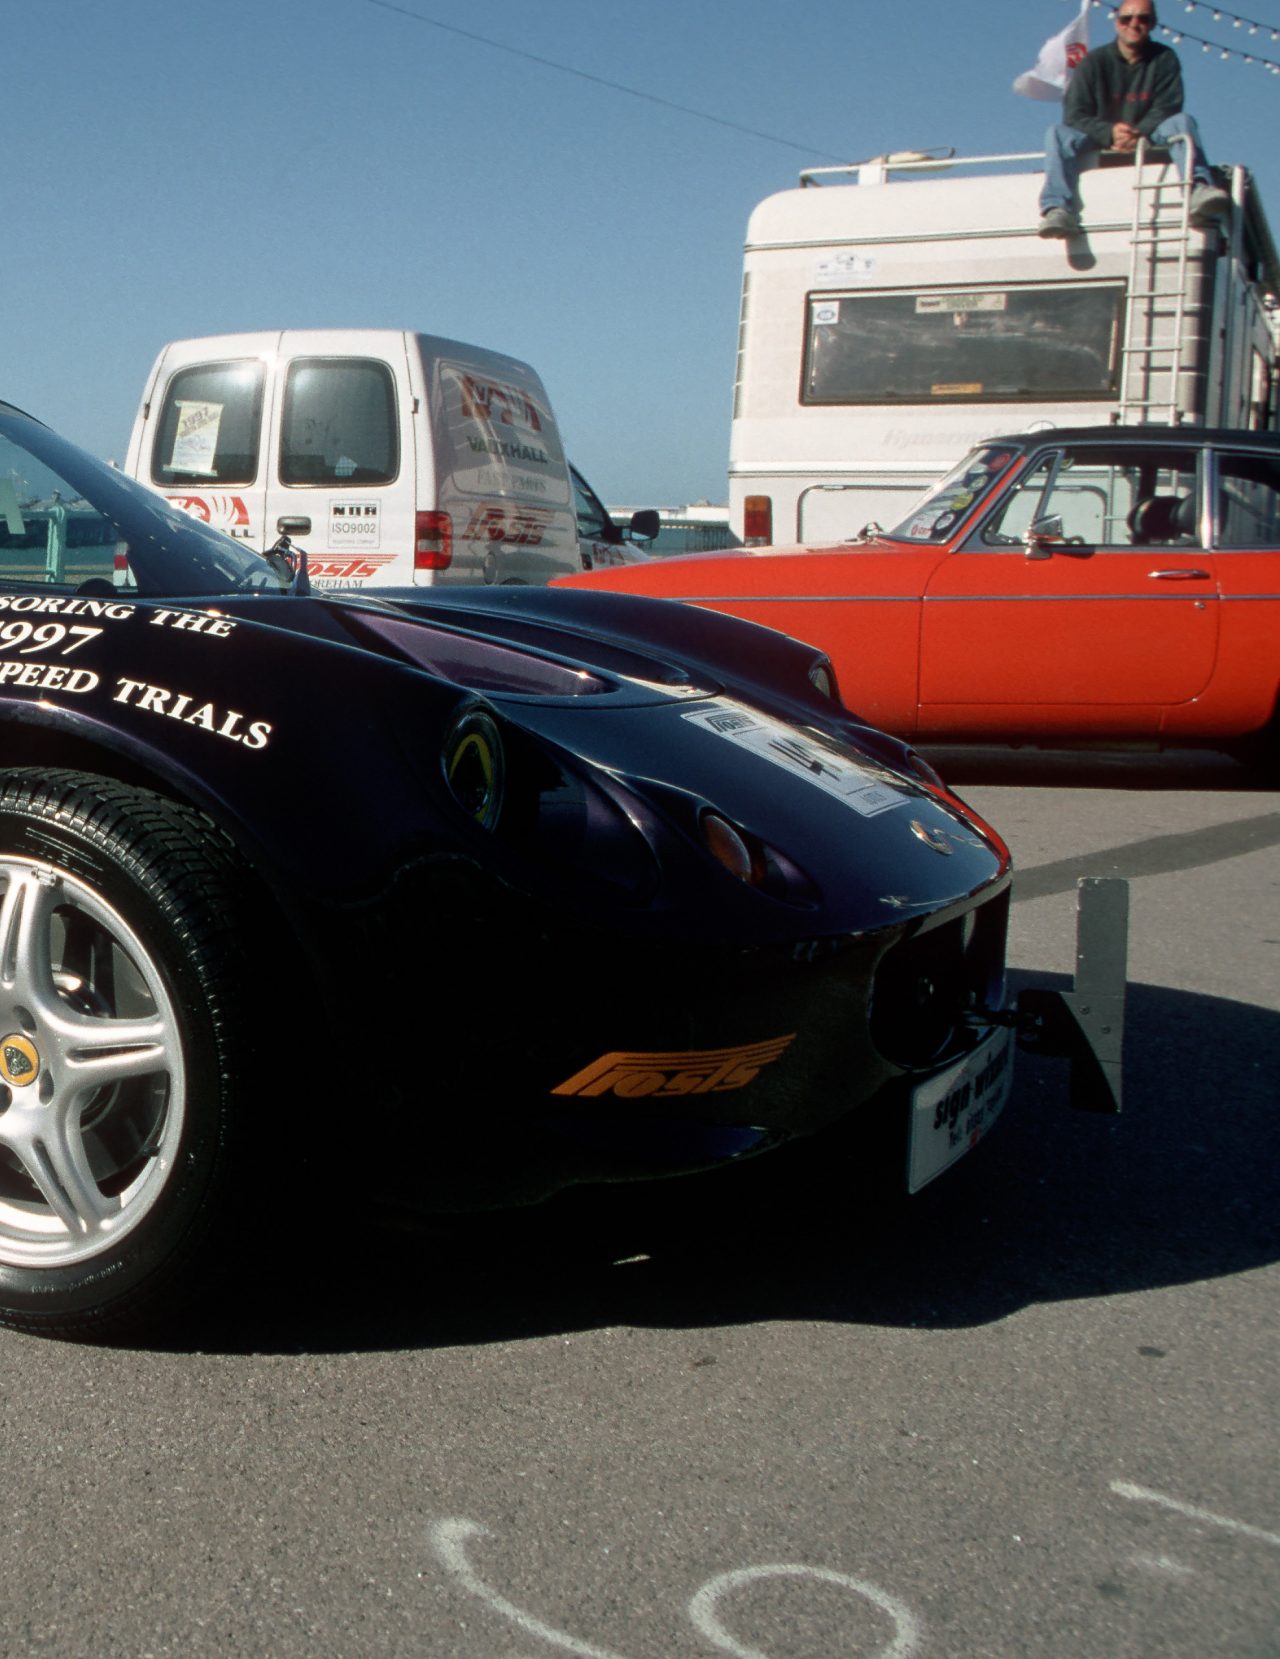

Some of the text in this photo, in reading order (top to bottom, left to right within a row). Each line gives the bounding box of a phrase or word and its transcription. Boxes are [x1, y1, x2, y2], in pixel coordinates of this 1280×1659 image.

[332, 522, 377, 534] ISO9002
[153, 608, 238, 638] THE
[112, 676, 273, 752] TRIALS
